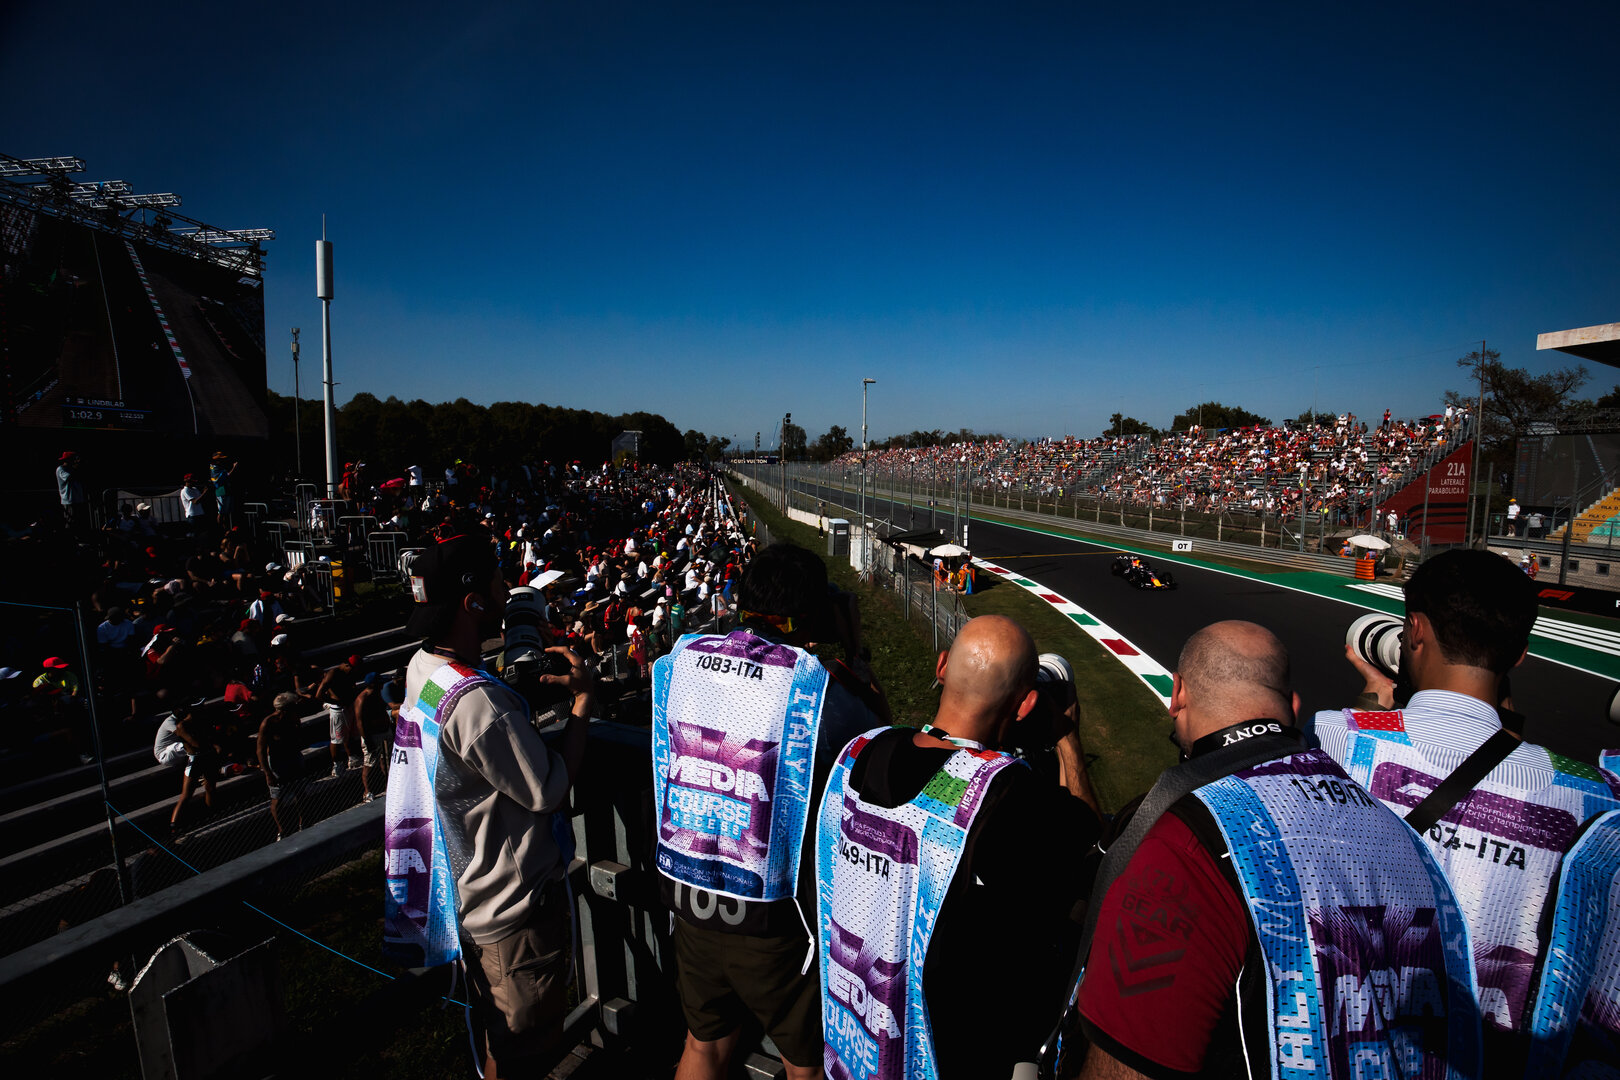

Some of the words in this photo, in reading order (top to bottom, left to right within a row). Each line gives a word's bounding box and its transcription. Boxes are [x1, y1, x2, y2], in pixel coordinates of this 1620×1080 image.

[1447, 462, 1466, 476] 21A
[1428, 487, 1460, 495] PARABOLICA
[1440, 478, 1465, 486] LATERALE
[696, 654, 764, 681] 1083-ITA
[784, 687, 818, 774] ITALY
[1222, 722, 1282, 747] SONY
[669, 751, 770, 802] MEDIA
[668, 786, 749, 828] COURSE
[672, 811, 740, 836] ACCESS
